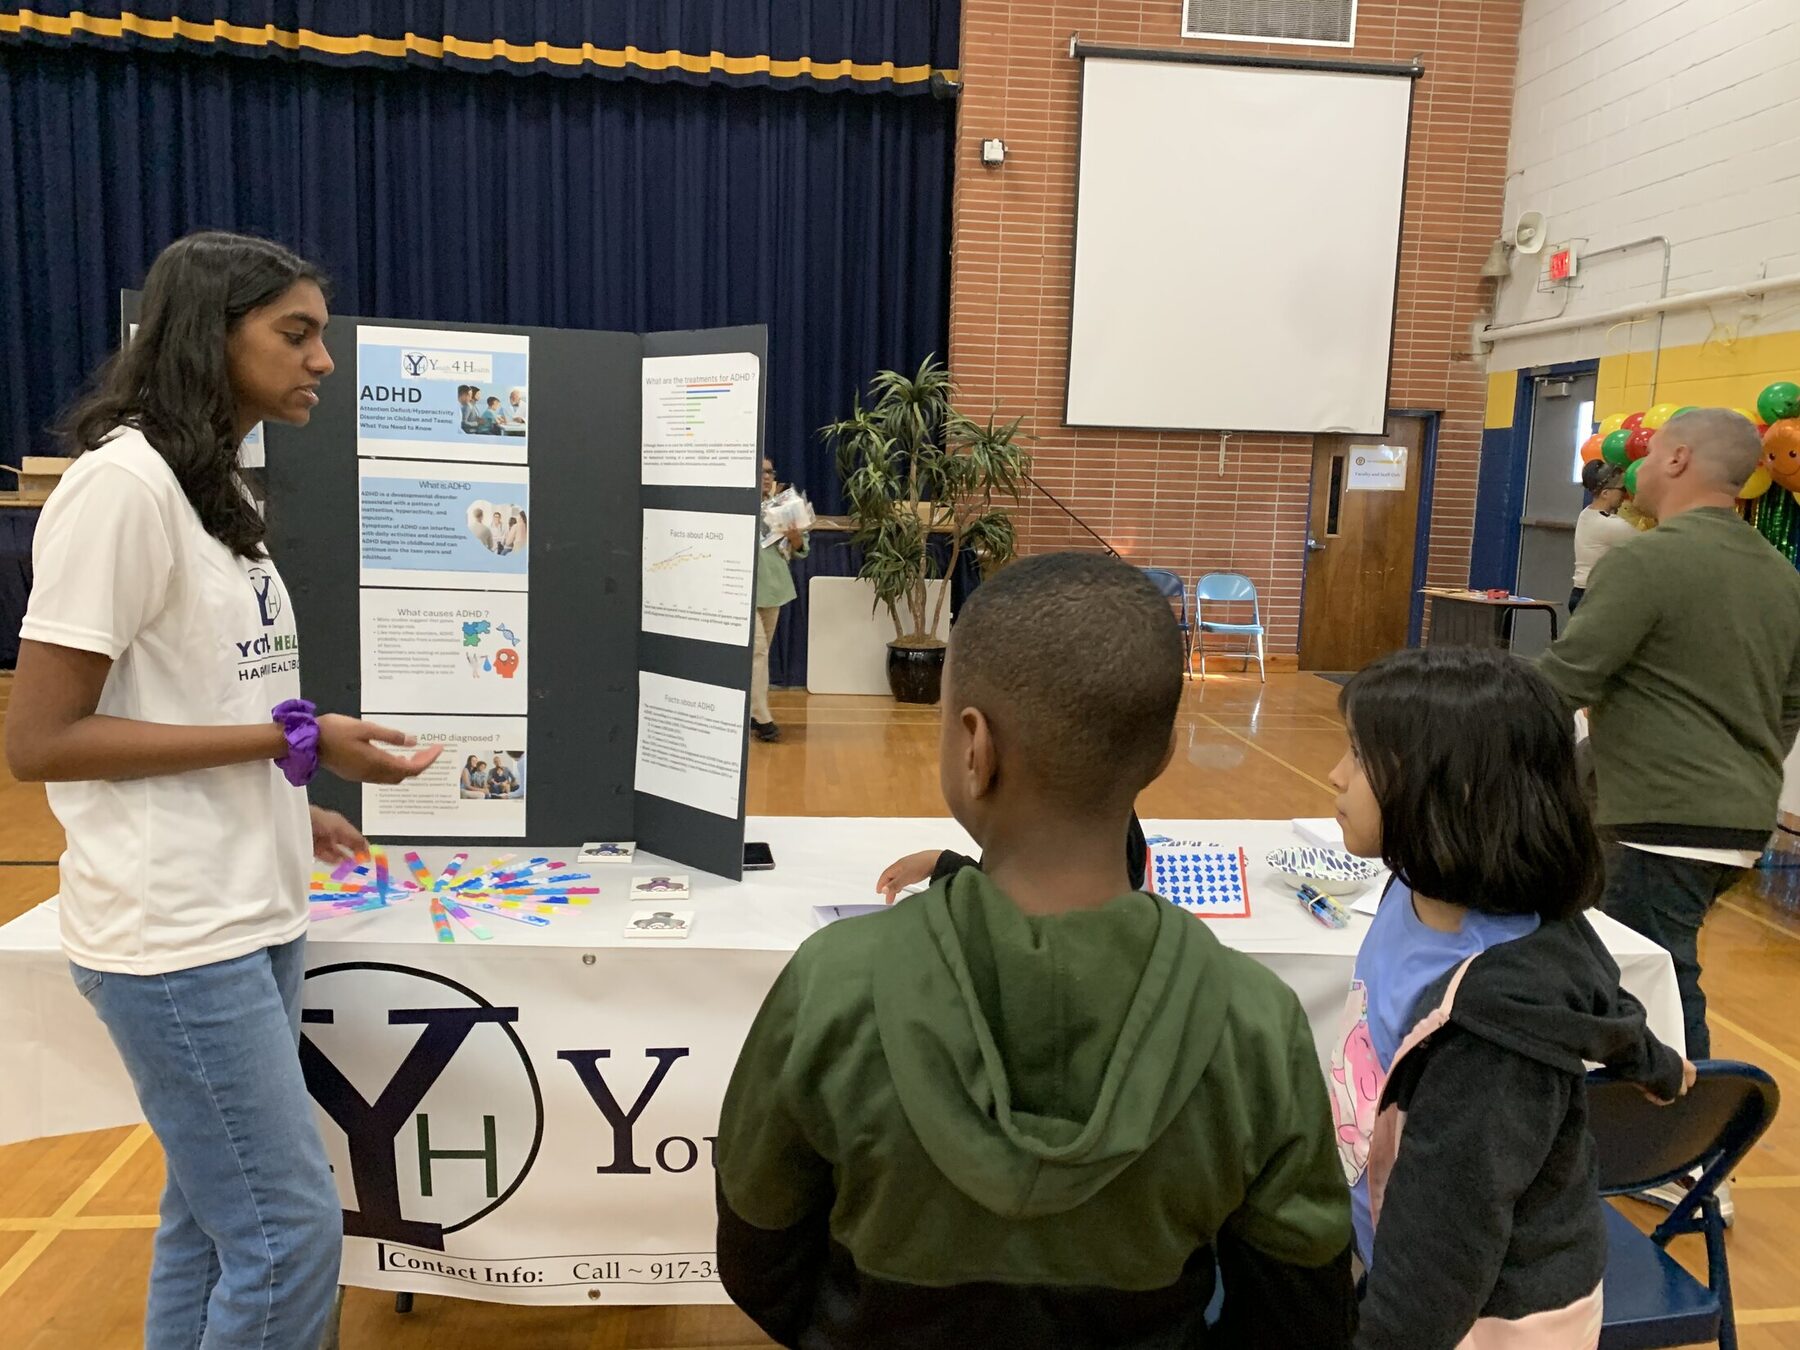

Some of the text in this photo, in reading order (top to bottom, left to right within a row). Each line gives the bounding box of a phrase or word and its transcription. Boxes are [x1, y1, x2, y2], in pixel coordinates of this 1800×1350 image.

[360, 385, 422, 403] ADHD
[418, 481, 440, 489] What
[447, 482, 471, 490] ADHD
[397, 609, 420, 617] What
[422, 609, 454, 617] causes
[455, 610, 483, 618] ADHD
[448, 734, 493, 743] diagnosed
[416, 1113, 499, 1198] H
[388, 1251, 477, 1280] Contact
[484, 1266, 543, 1284] Info:
[572, 1260, 621, 1280] Call
